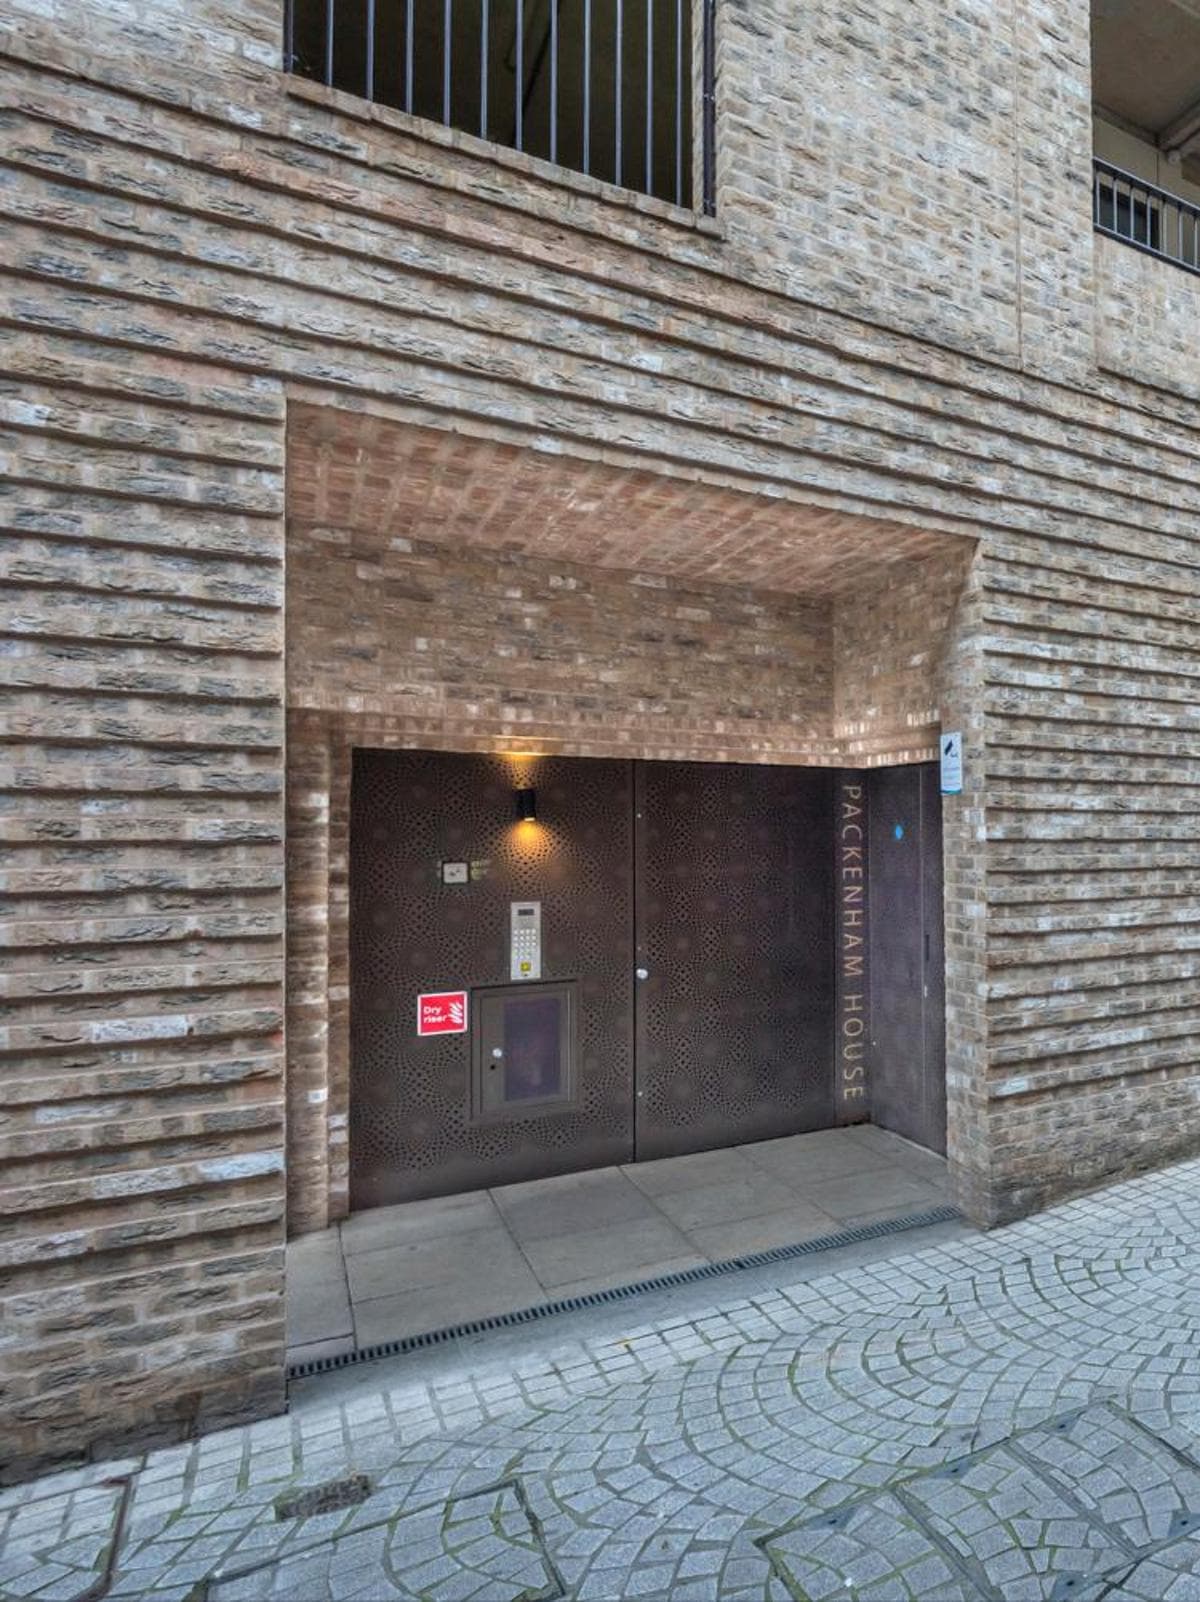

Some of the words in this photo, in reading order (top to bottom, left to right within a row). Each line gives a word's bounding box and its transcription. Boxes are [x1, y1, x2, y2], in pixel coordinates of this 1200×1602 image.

[842, 785, 864, 977] PACKENHAM
[424, 1006, 442, 1015] Dry
[424, 1015, 447, 1023] riser
[843, 994, 864, 1101] HOUSE
